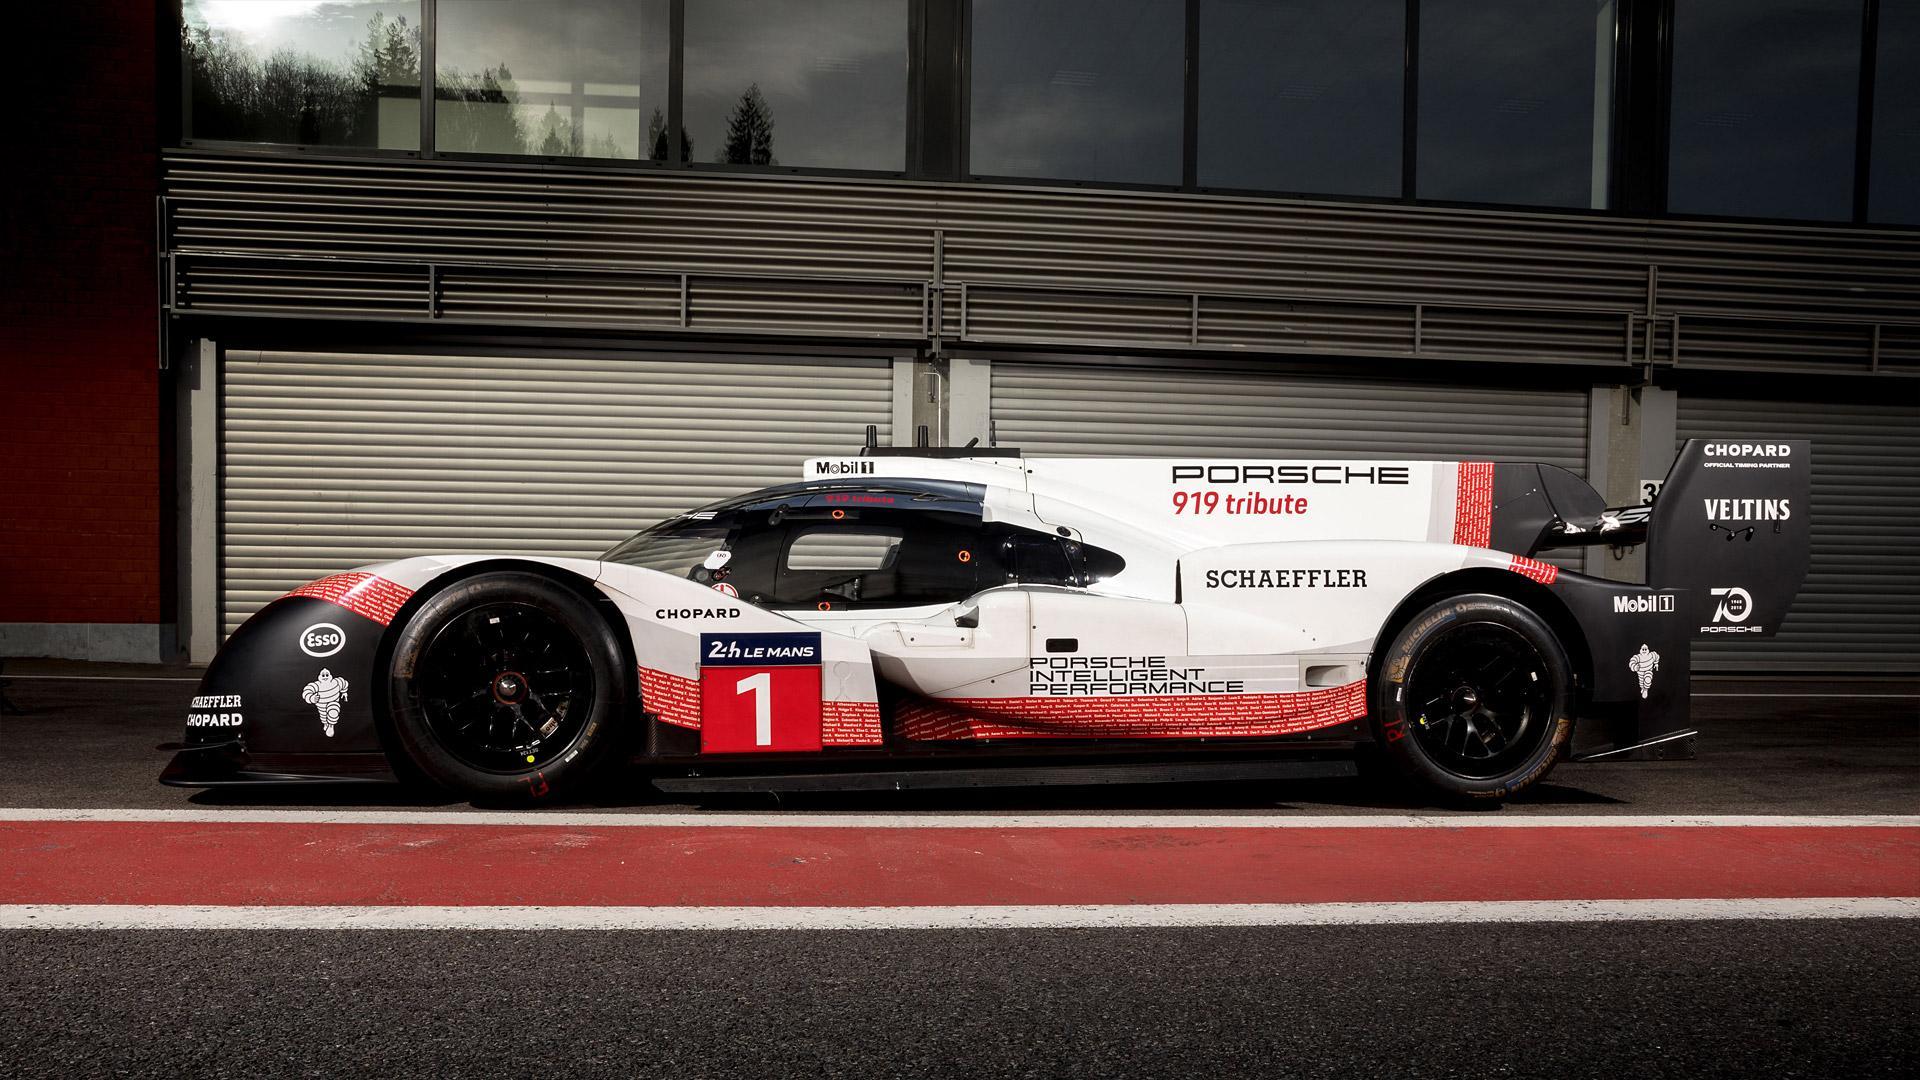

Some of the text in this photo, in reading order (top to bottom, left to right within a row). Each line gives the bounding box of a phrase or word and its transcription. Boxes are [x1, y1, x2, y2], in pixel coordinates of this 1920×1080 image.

[1703, 443, 1791, 457] CHOPARD
[816, 462, 858, 475] Mobil
[1172, 465, 1409, 485] PORSCHE
[1172, 491, 1308, 515] 919 tribute
[1703, 498, 1791, 521] VELTINS
[1206, 569, 1368, 589] SCHAEFFLER
[1613, 595, 1657, 613] Mobil
[1710, 587, 1753, 623] 70
[655, 608, 741, 619] CHOPARD
[708, 640, 814, 658] 24h LE MANS
[1029, 656, 1166, 669] PORSCHE
[1029, 668, 1205, 683] INTELLIGENT
[1029, 680, 1244, 696] PERFORMANCE
[736, 672, 771, 746] 1
[187, 713, 243, 727] CHOPARD
